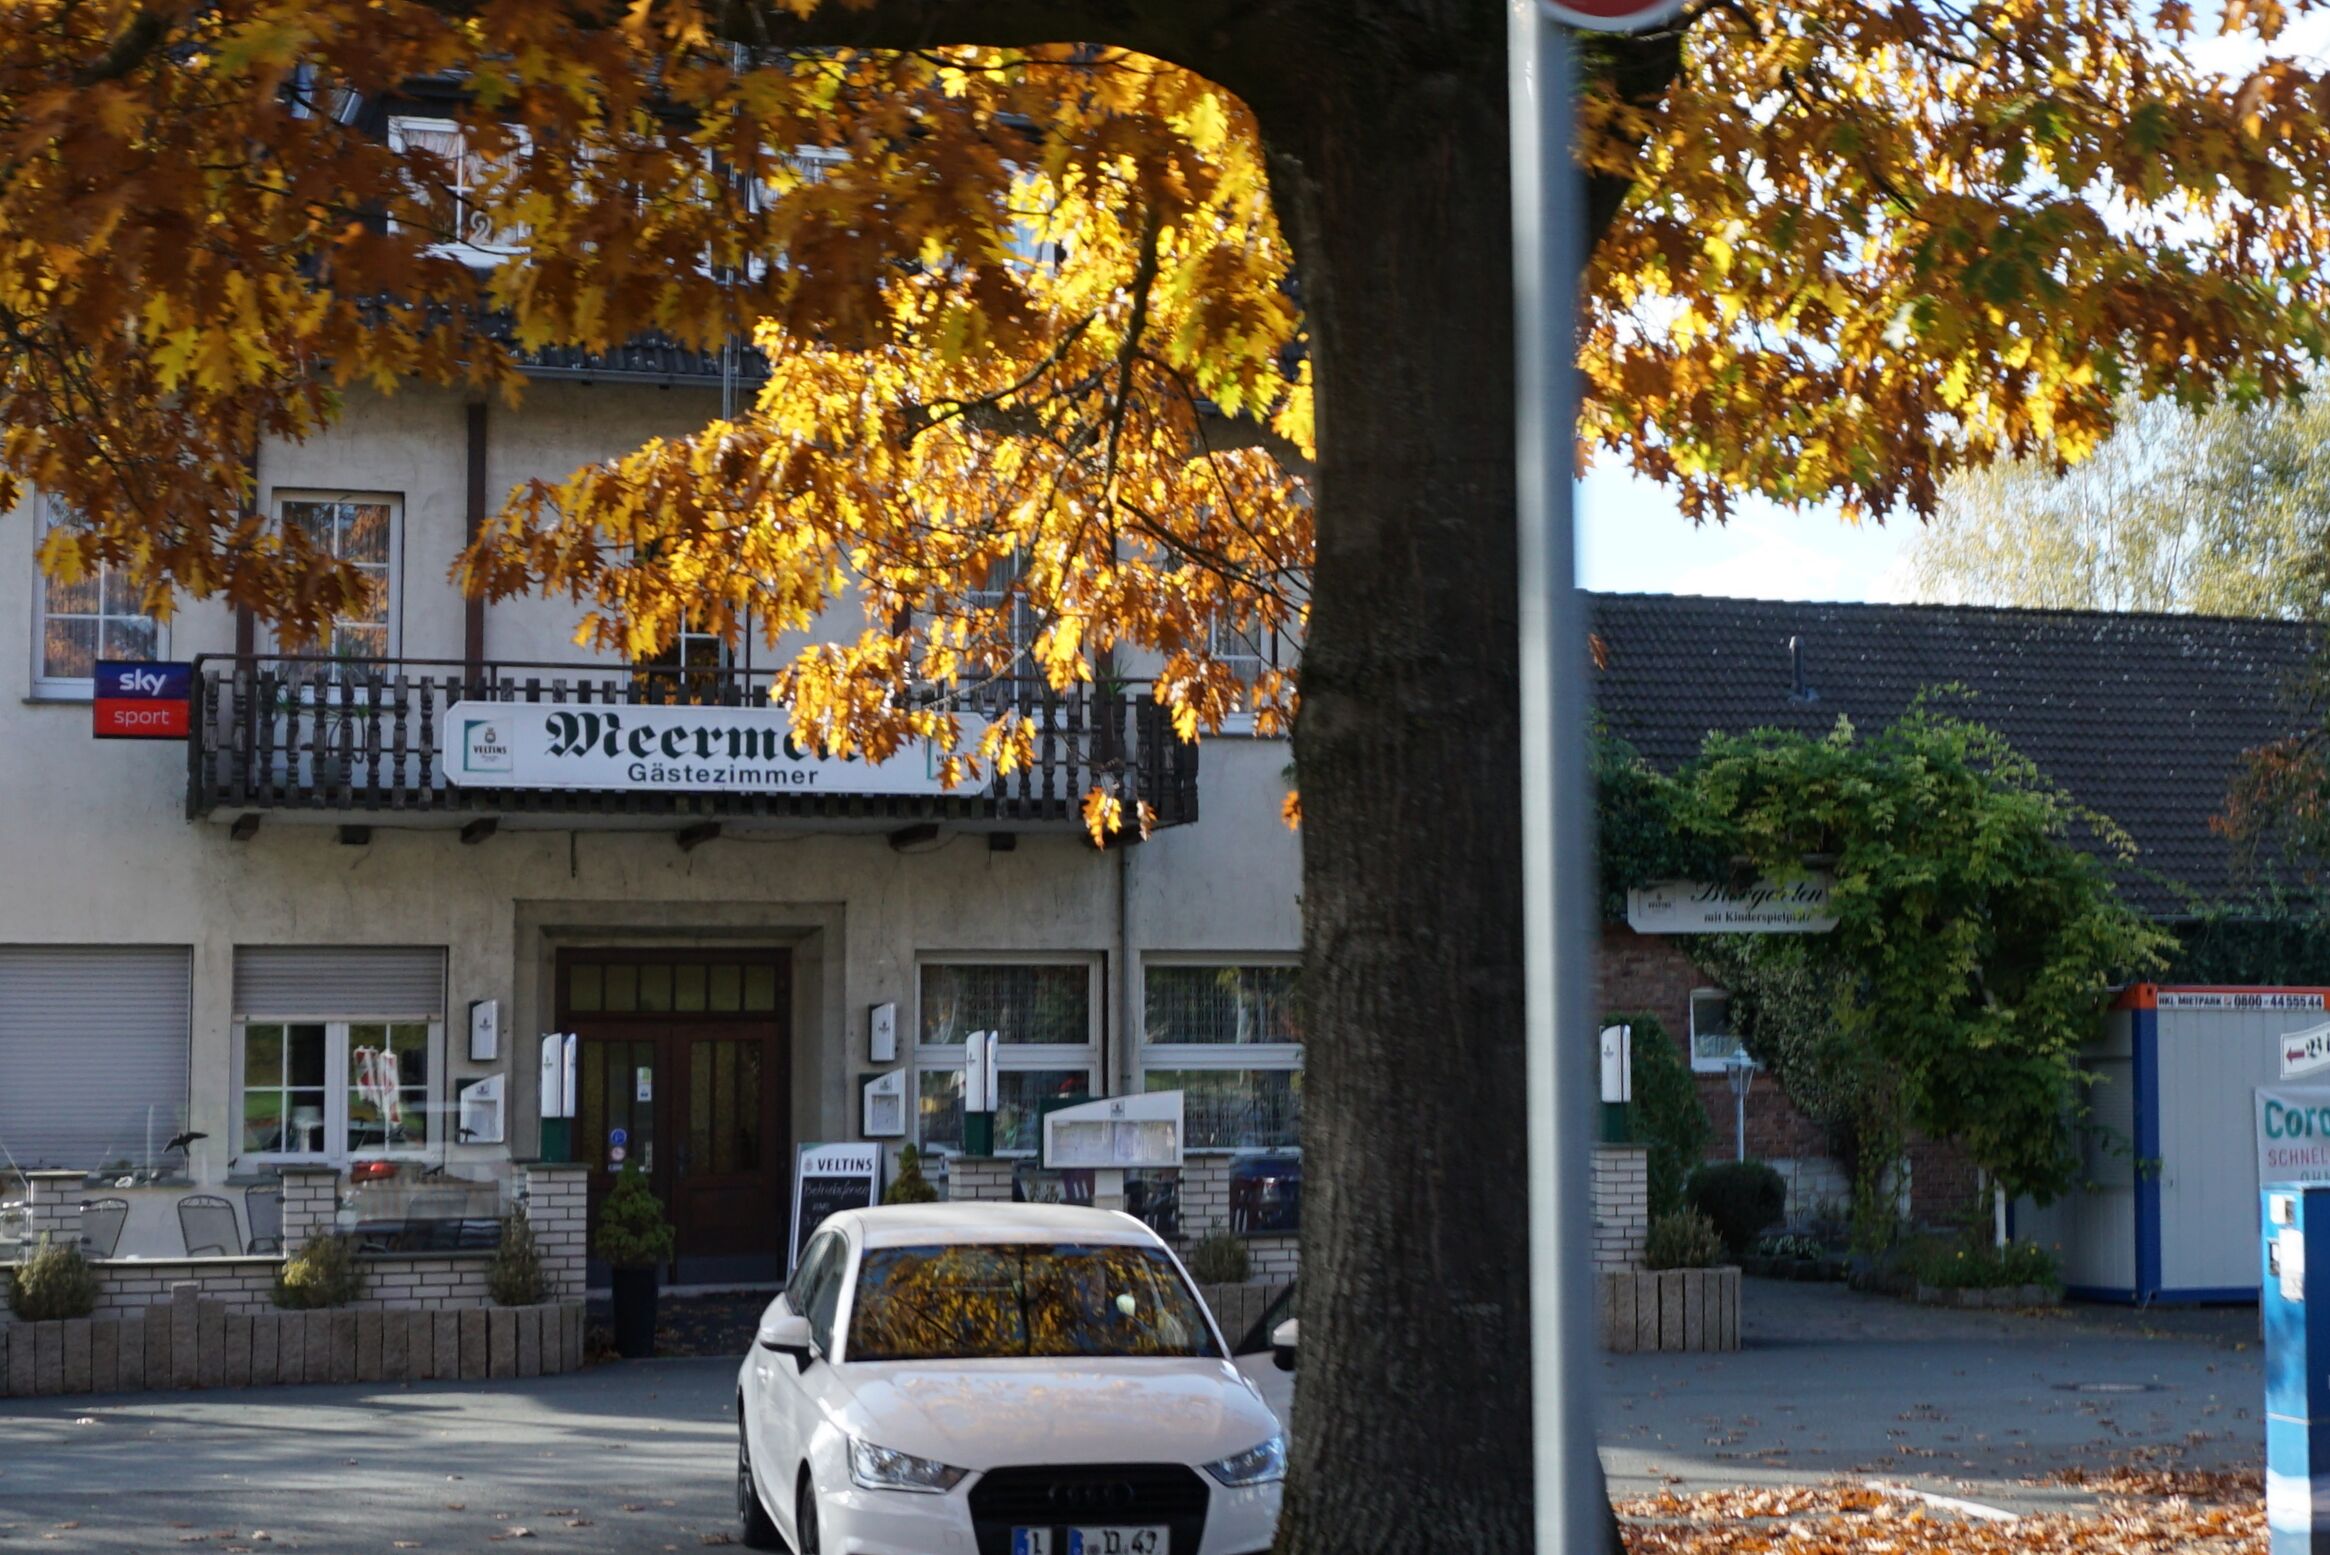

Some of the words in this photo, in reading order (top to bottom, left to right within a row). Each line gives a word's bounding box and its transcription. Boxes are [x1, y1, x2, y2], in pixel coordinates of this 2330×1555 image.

[119, 668, 167, 697] sky
[113, 710, 169, 727] sport
[627, 762, 820, 785] Gästezimmer
[1704, 912, 1721, 923] mit
[817, 1158, 873, 1171] VELTINS
